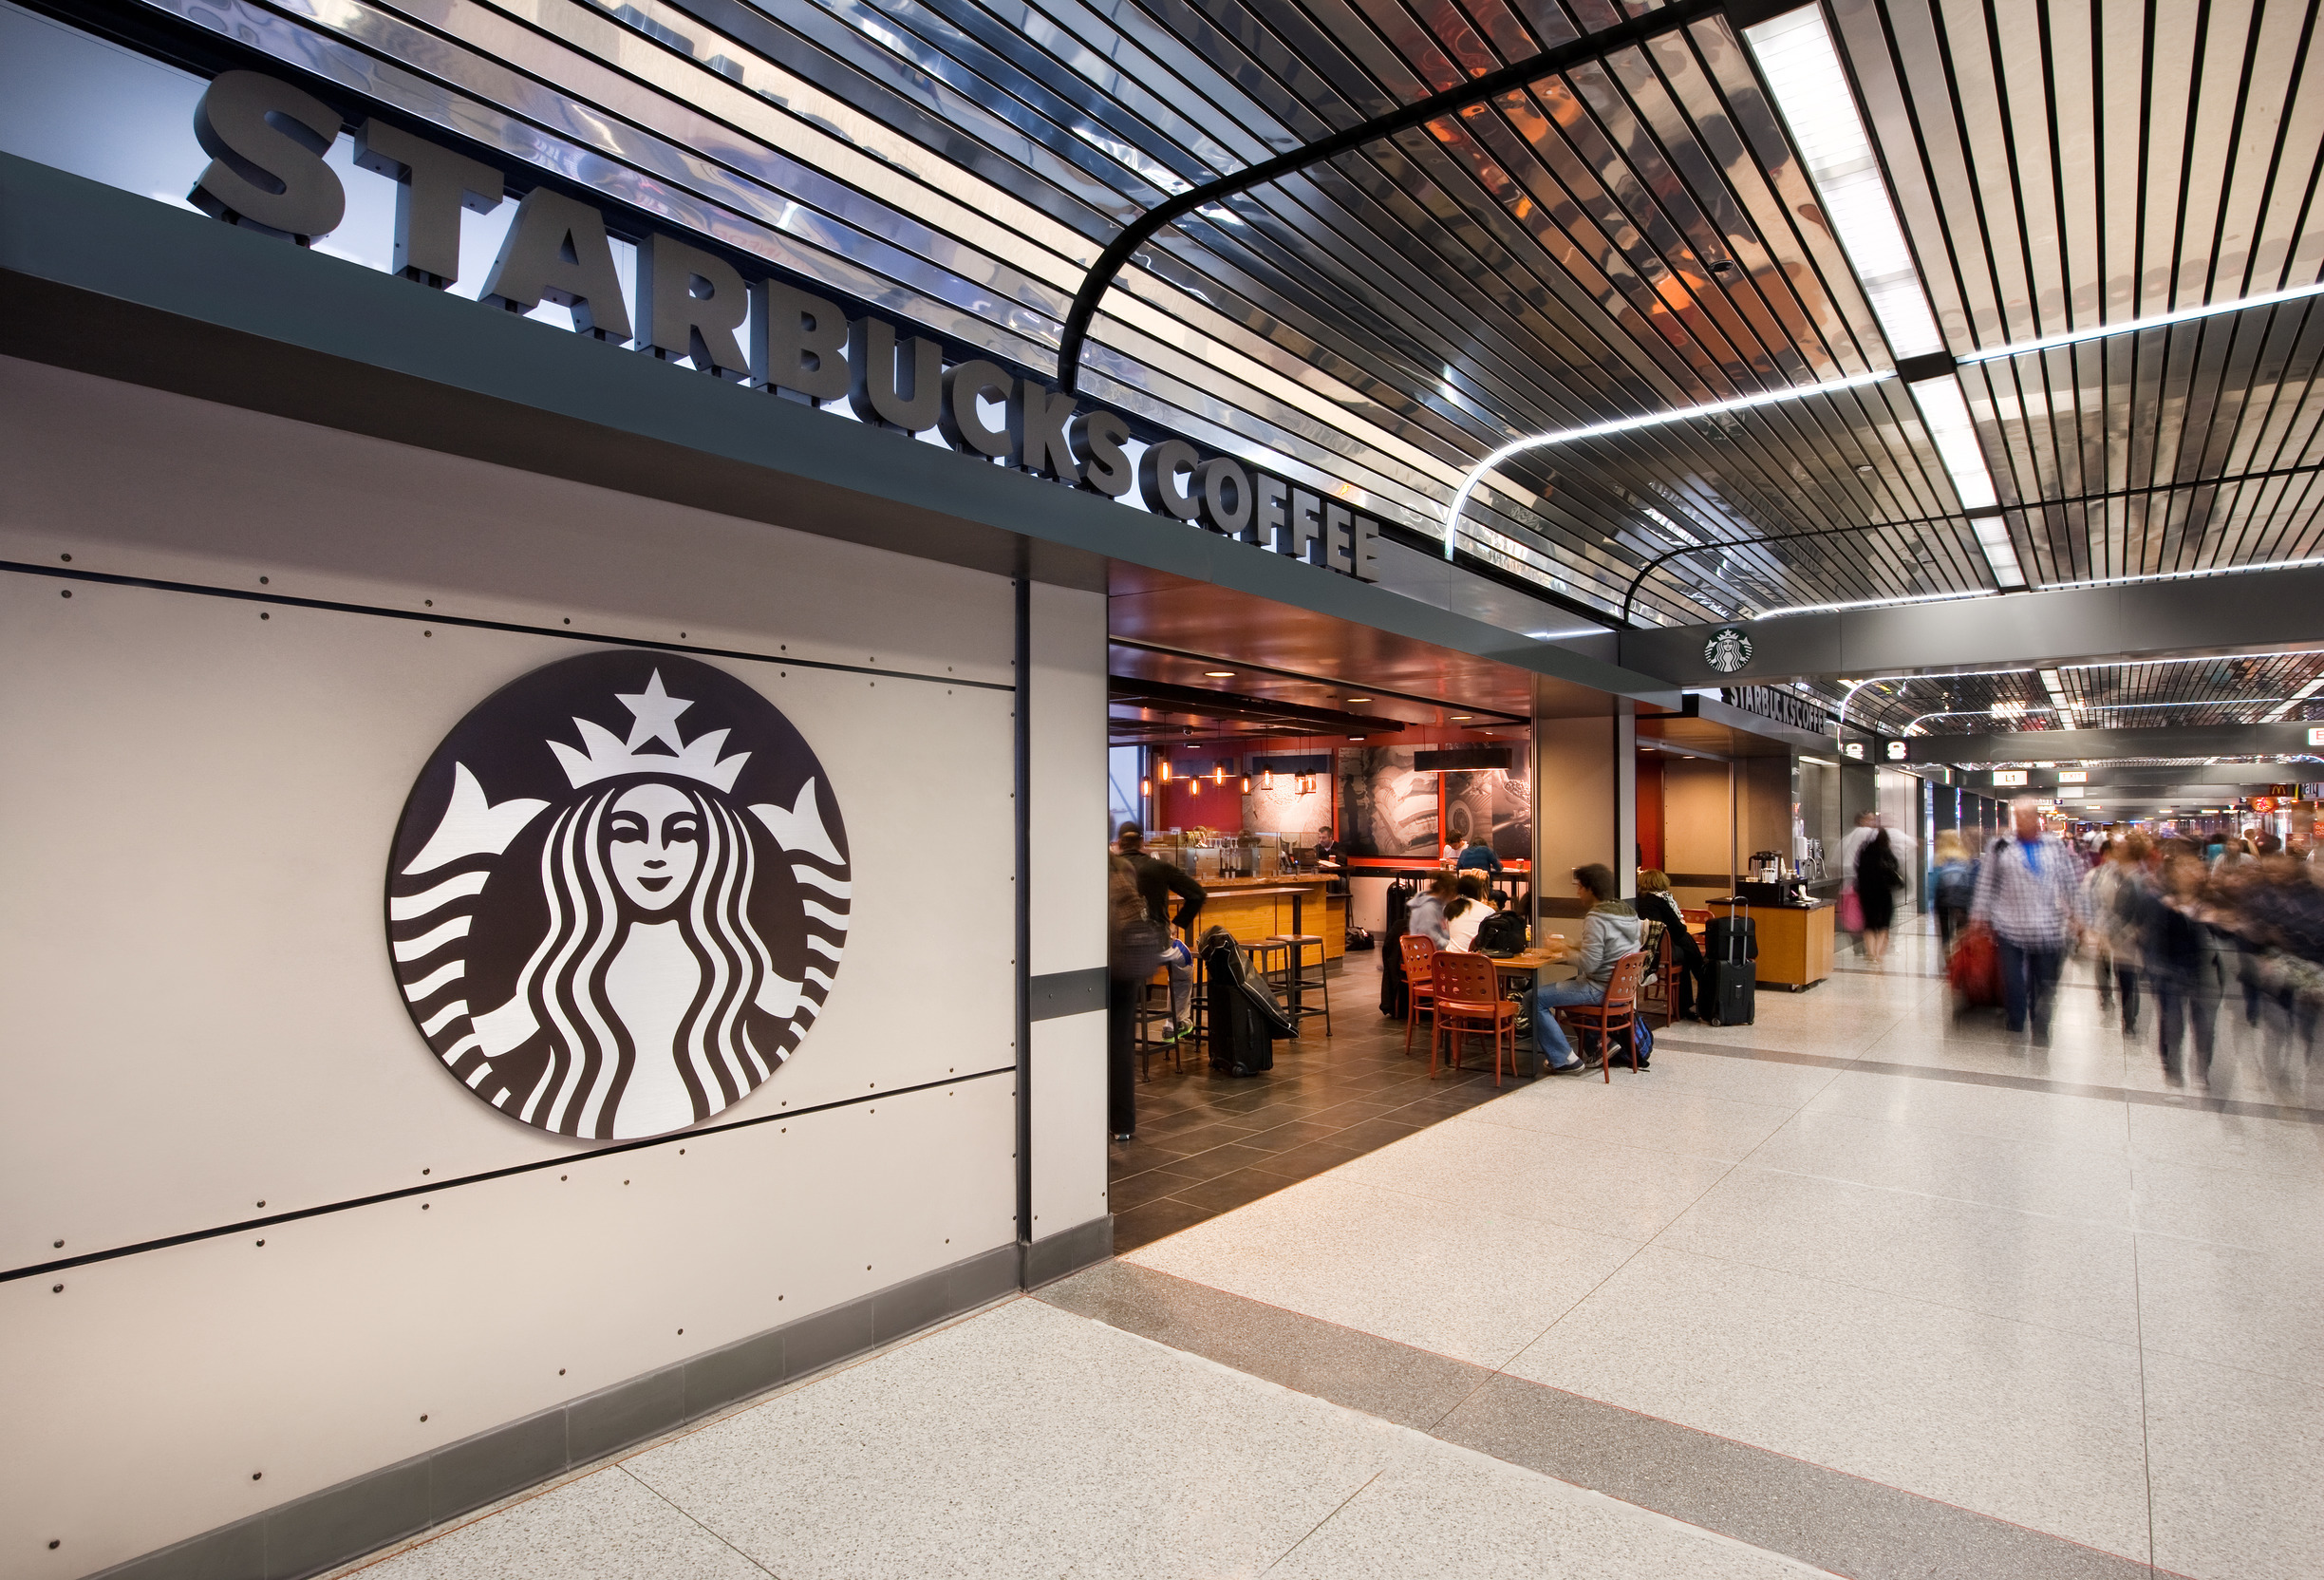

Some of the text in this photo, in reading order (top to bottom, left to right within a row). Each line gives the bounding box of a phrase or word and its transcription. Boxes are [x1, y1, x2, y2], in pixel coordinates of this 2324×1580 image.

[186, 69, 1379, 582] STARBUCKS COFFEE
[1729, 685, 1827, 735] STARBUCKS COFFEE
[2005, 774, 2015, 782] L1
